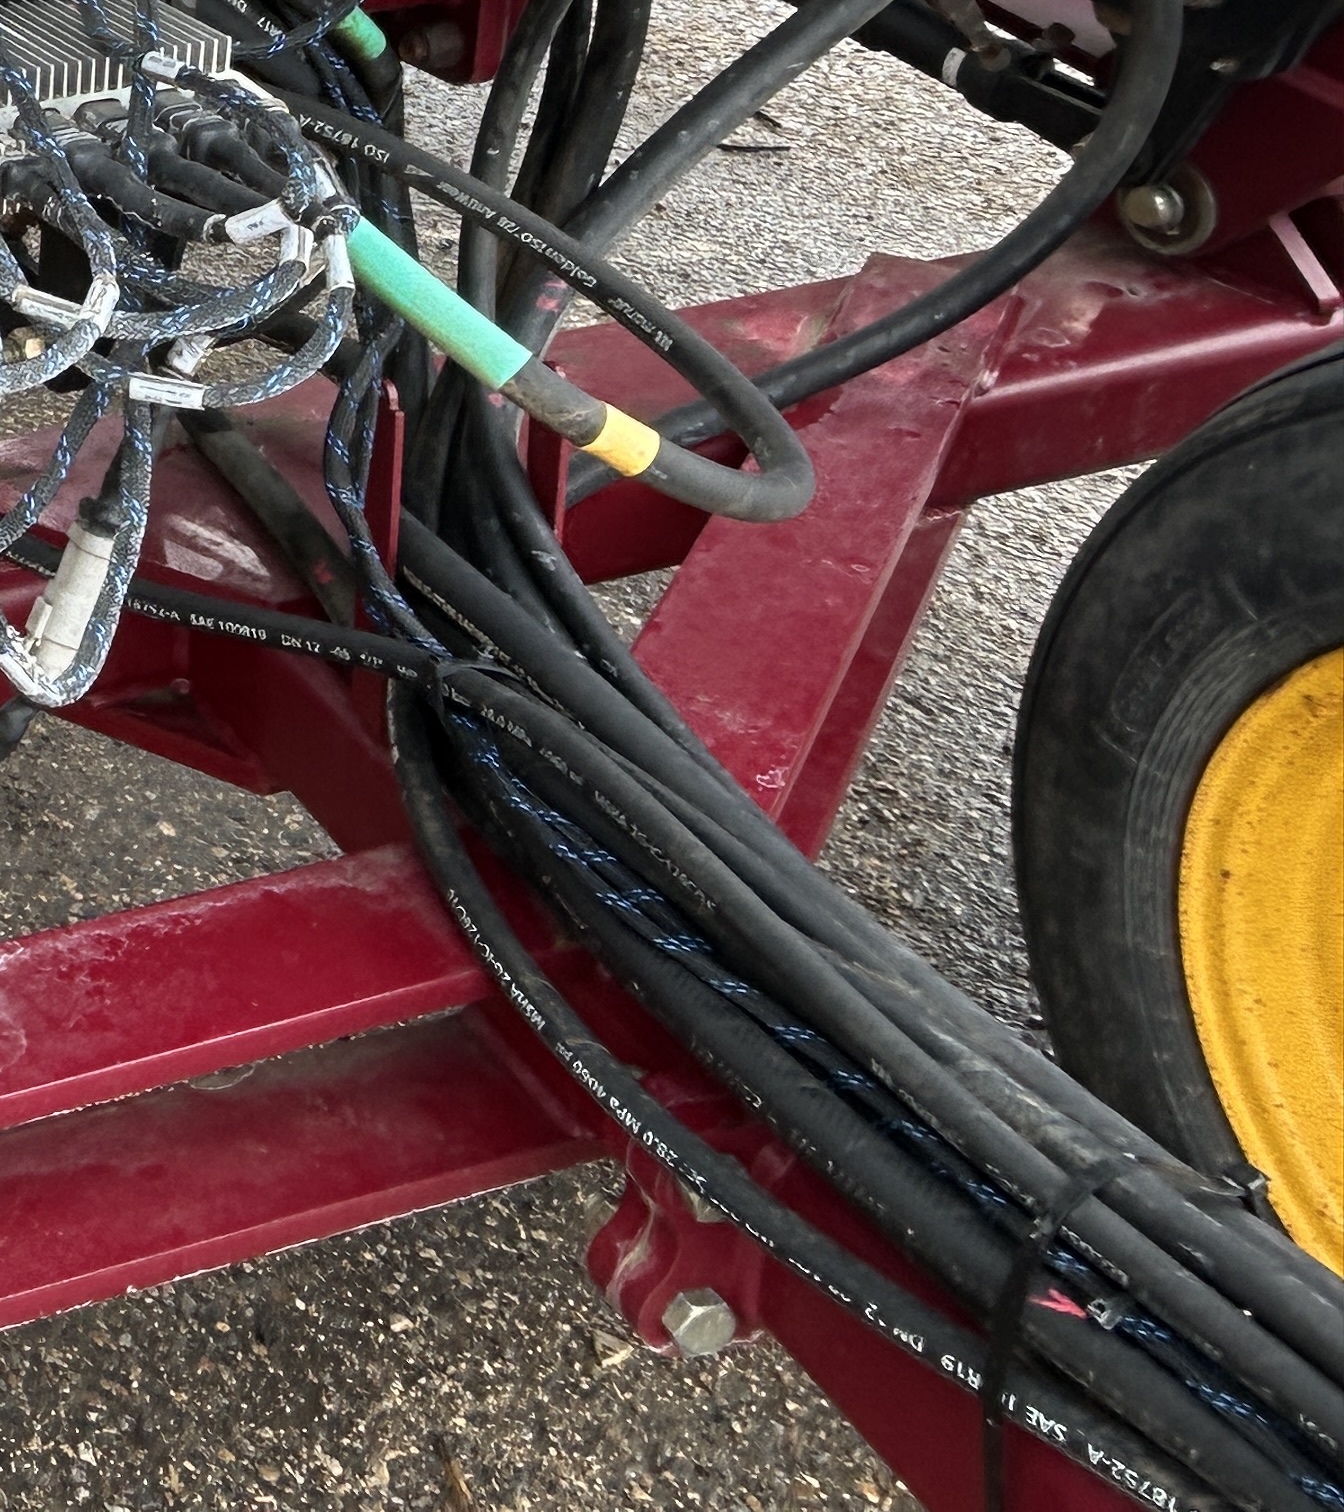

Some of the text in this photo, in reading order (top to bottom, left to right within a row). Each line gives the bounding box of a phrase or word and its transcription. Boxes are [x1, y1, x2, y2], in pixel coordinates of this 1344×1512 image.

[361, 141, 391, 165] ISO
[603, 1090, 645, 1135] MPa
[642, 1129, 683, 1169] 28.0
[1019, 1401, 1072, 1444] SAE
